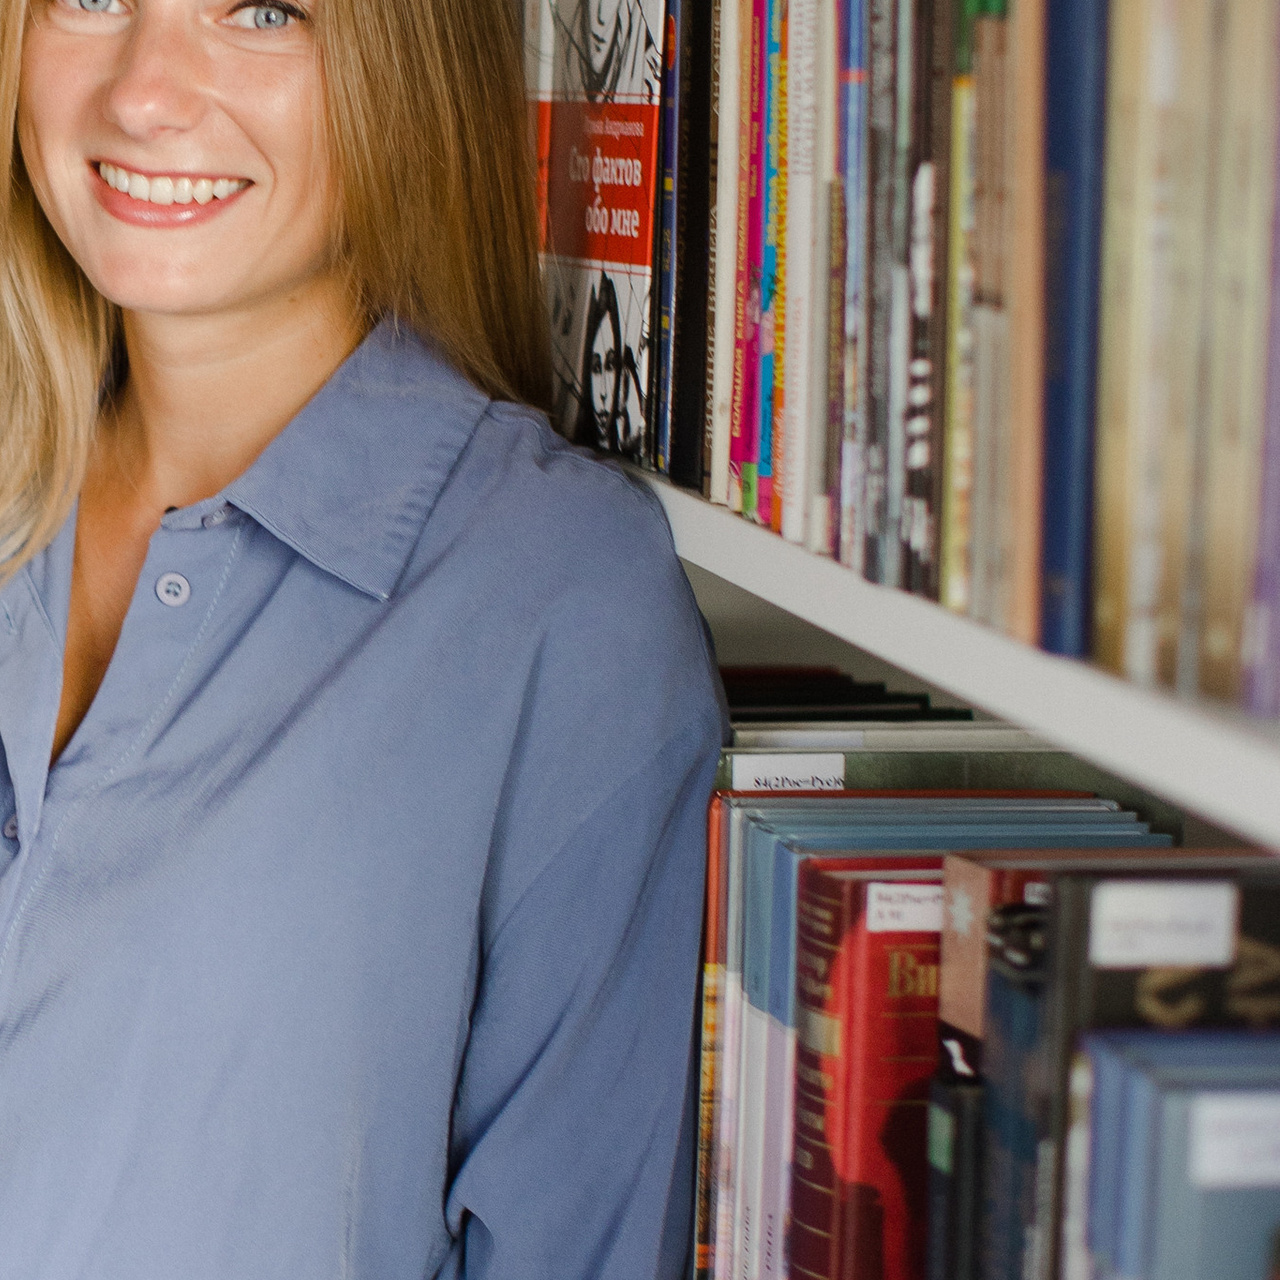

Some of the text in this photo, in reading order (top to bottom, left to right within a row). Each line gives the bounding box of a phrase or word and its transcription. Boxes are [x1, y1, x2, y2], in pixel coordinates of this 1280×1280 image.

[592, 147, 643, 194] фактов
[585, 195, 640, 239] обо мне
[737, 180, 747, 272] РОМАНОВ
[735, 280, 745, 339] КНИГА
[731, 348, 743, 438] БОЛЬШАЯ
